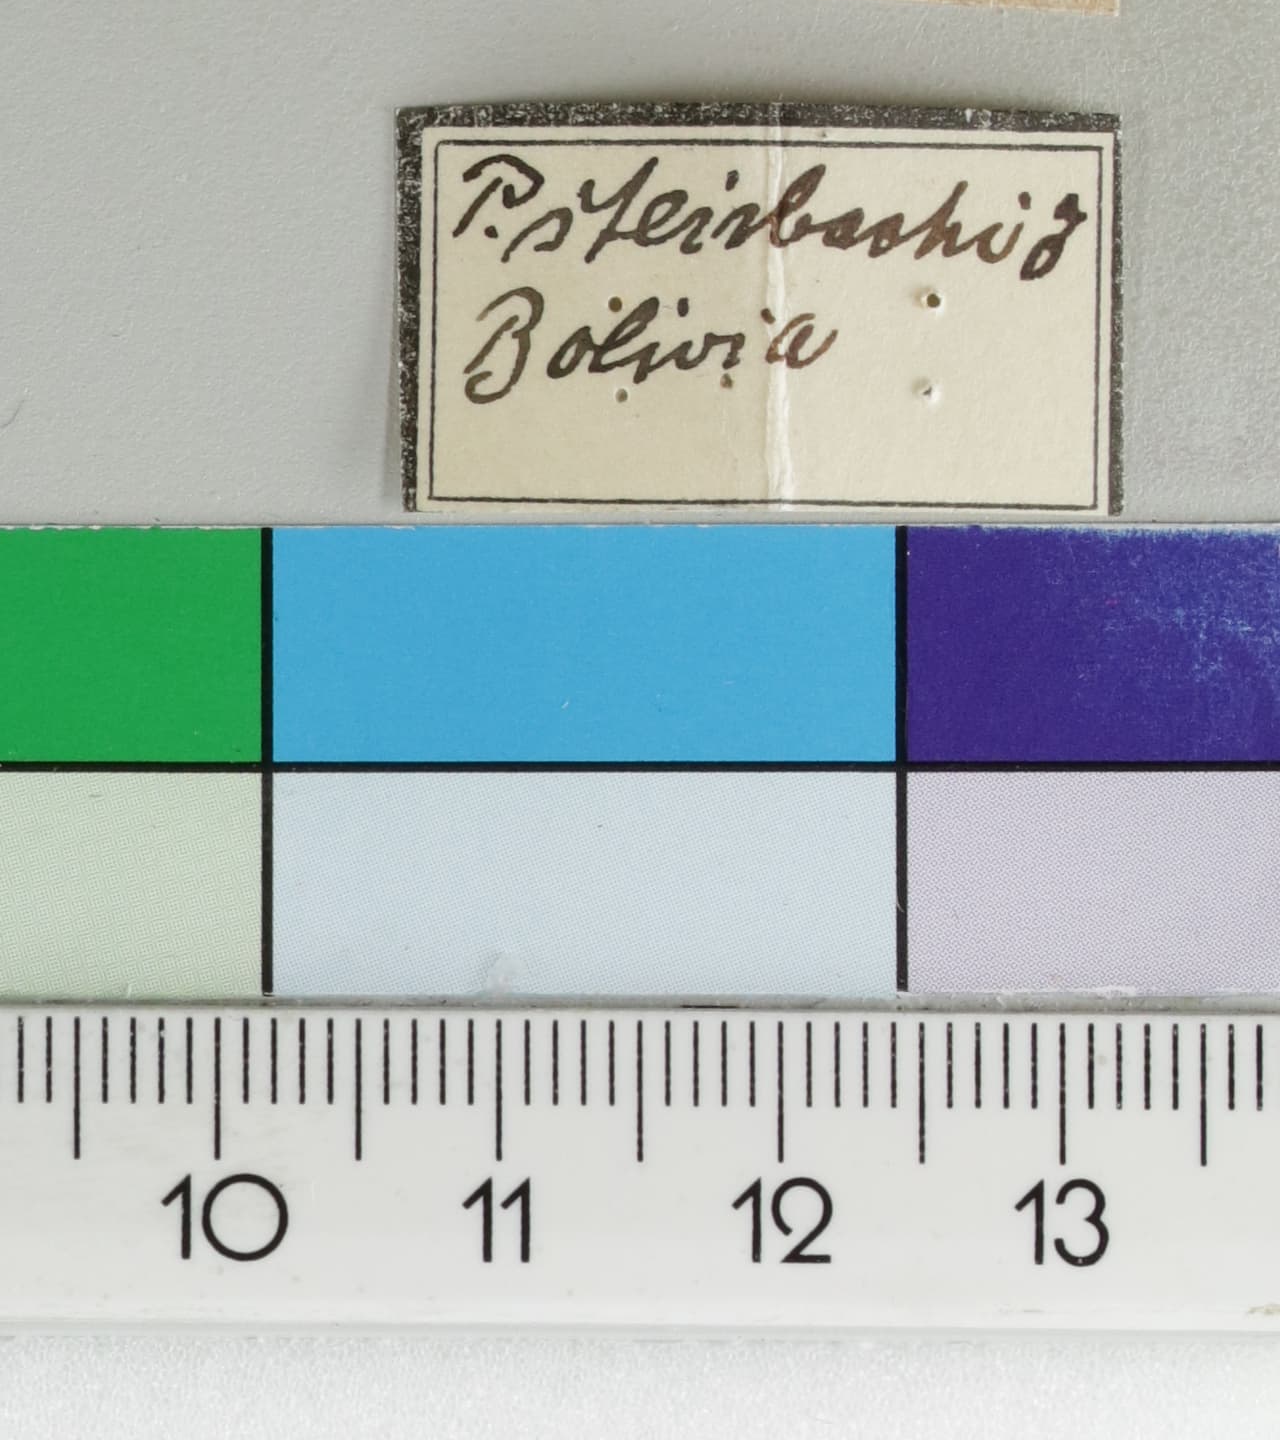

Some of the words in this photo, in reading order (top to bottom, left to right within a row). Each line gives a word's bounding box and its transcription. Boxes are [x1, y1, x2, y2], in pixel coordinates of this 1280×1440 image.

[160, 1172, 289, 1262] 10
[461, 1176, 531, 1264] 11
[731, 1176, 834, 1264] 12
[1014, 1178, 1110, 1268] 13
